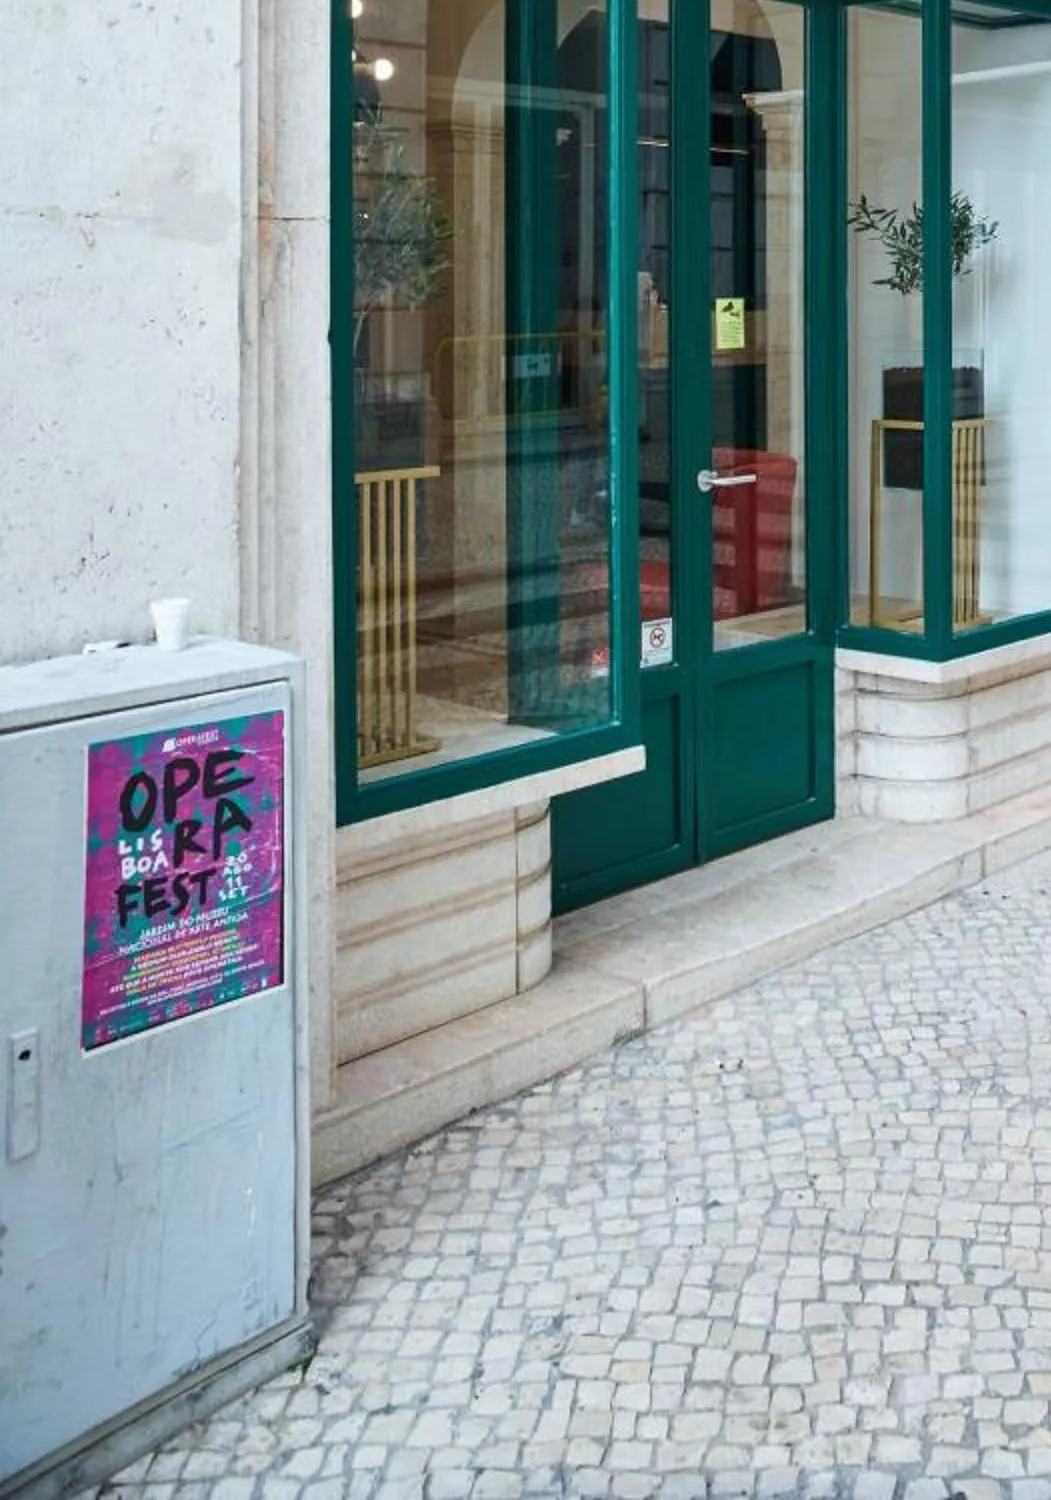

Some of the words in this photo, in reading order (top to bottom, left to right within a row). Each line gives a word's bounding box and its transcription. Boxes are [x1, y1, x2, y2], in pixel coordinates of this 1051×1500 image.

[120, 750, 256, 832] OPE
[118, 828, 163, 855] LIS
[174, 798, 253, 868] RA
[121, 851, 169, 880] BOA
[115, 868, 217, 928] FEST
